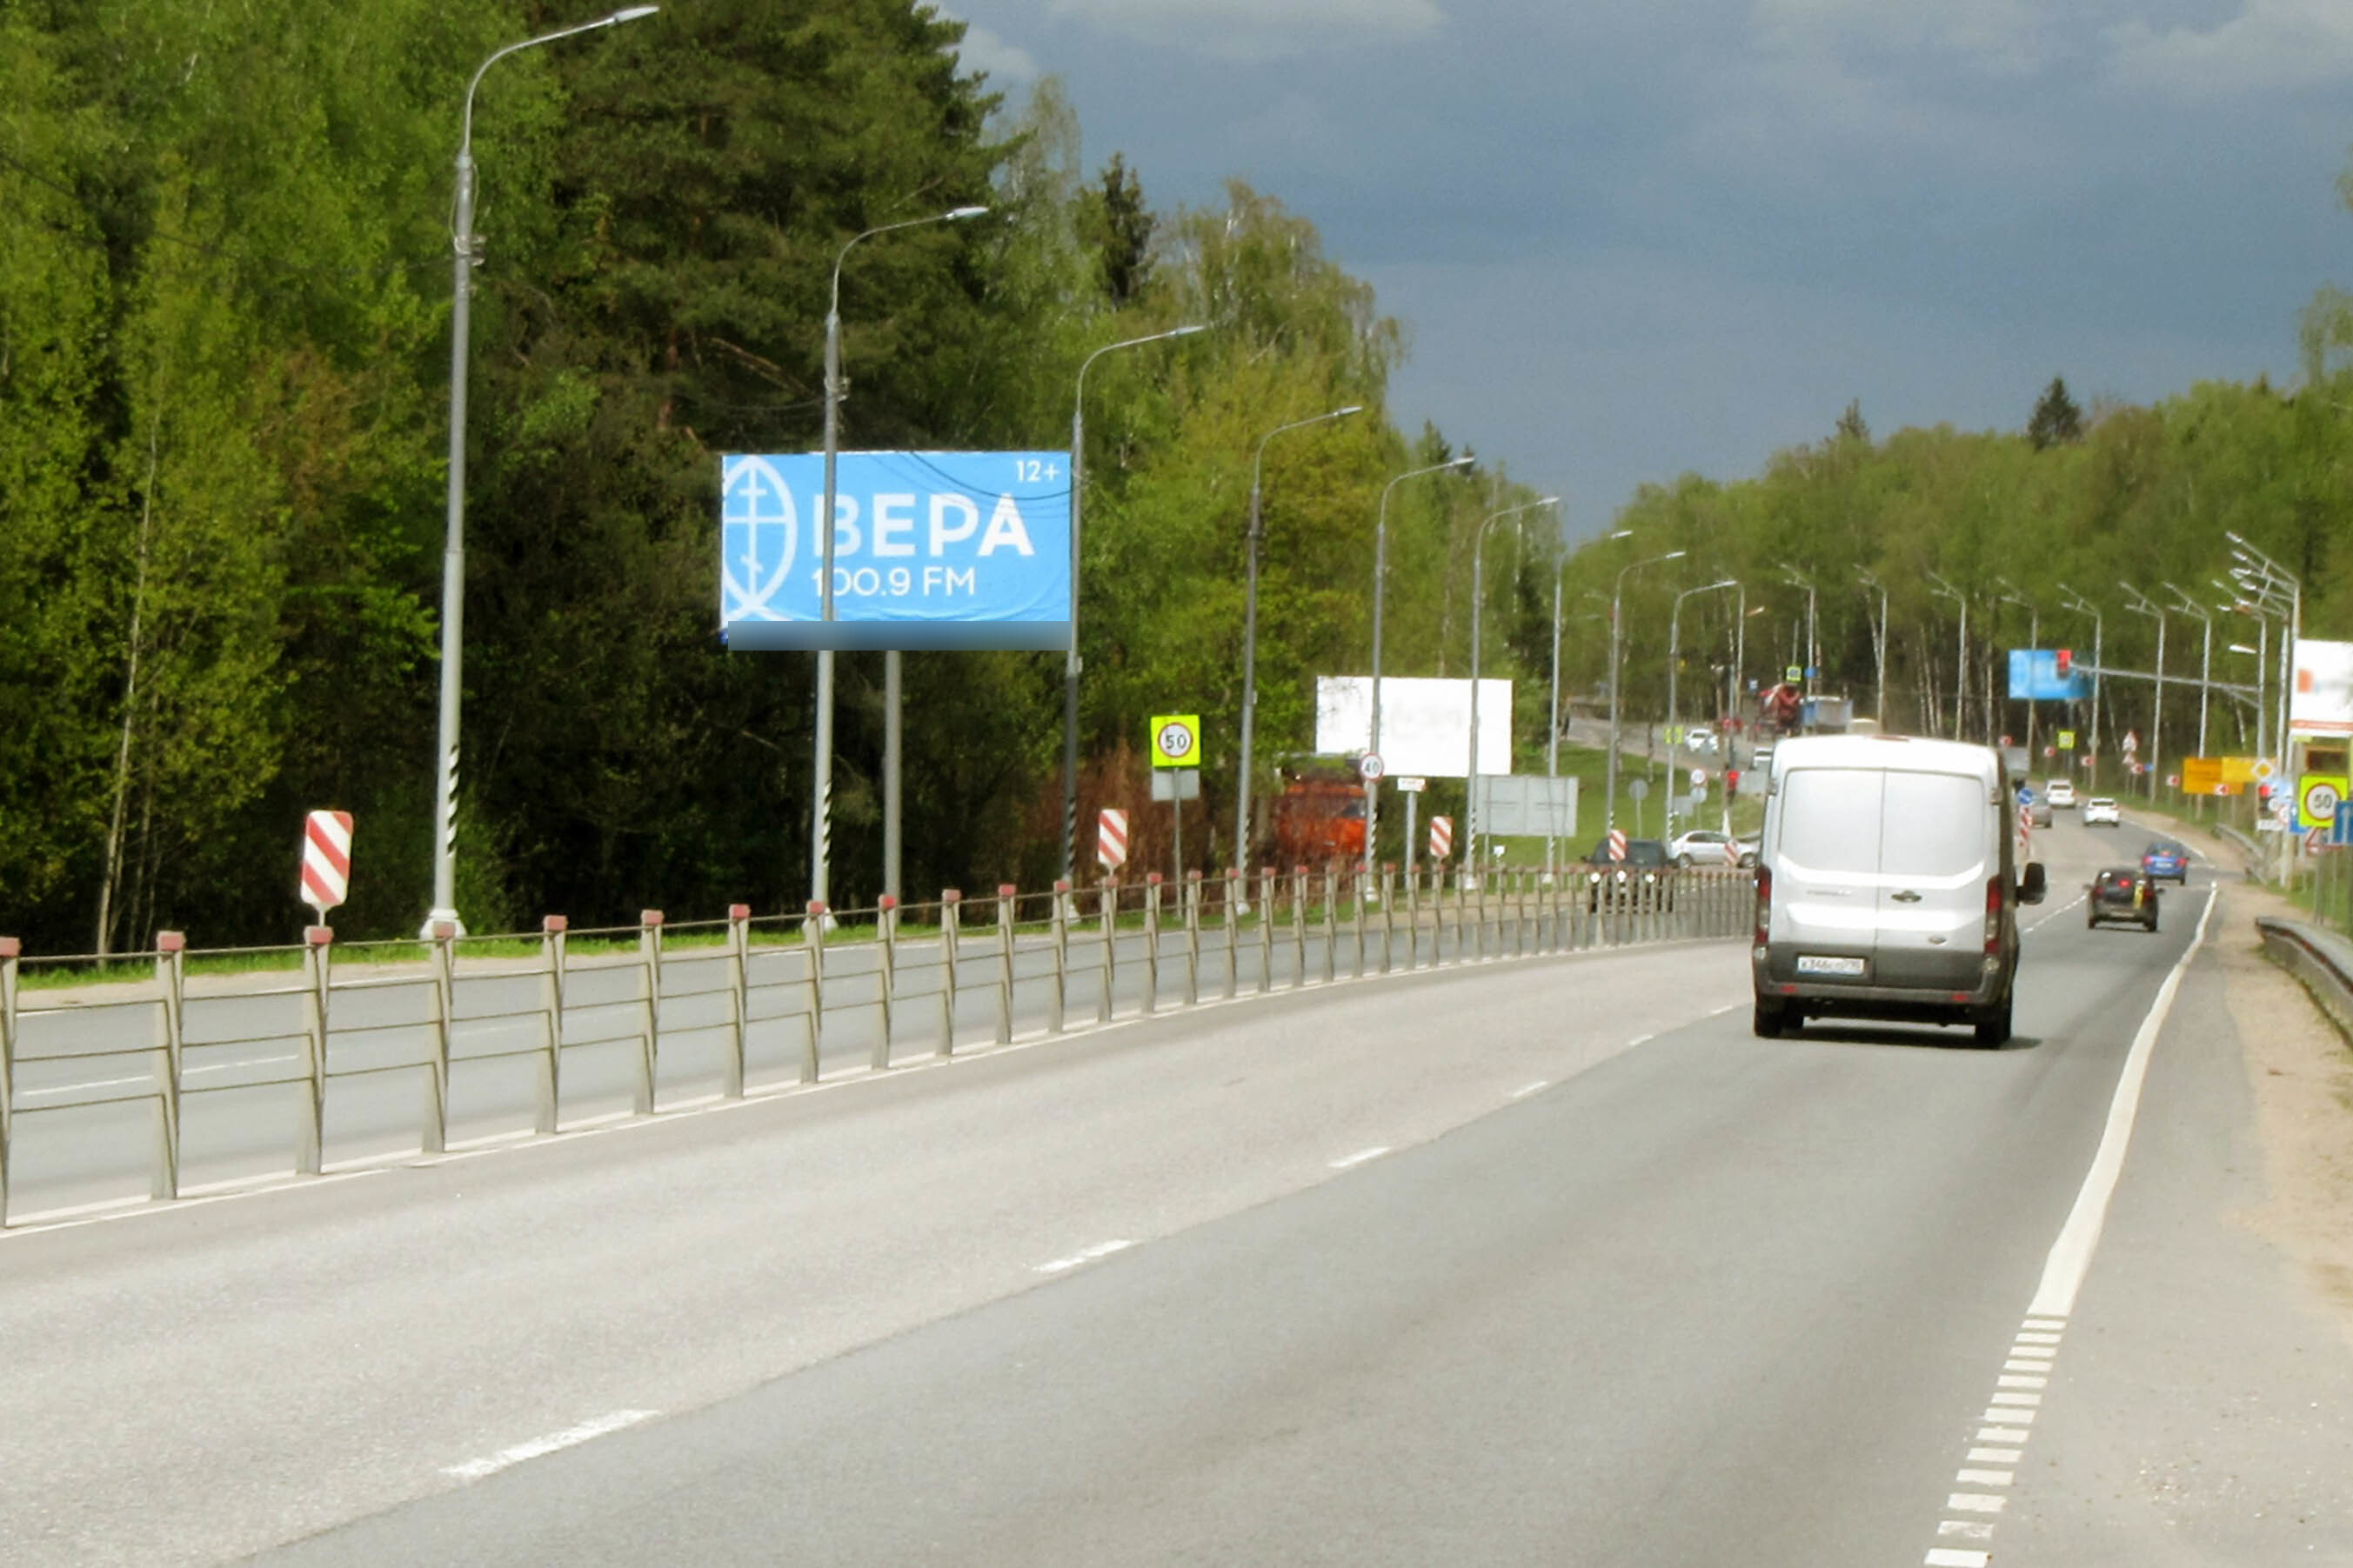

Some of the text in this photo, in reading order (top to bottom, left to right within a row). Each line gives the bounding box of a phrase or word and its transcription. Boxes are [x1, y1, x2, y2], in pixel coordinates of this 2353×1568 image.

[1016, 460, 1060, 482] 12+
[812, 492, 1035, 557] ВЕРА
[812, 567, 976, 597] 100.9 FM
[1166, 734, 1187, 750] 50
[2314, 793, 2332, 809] 50
